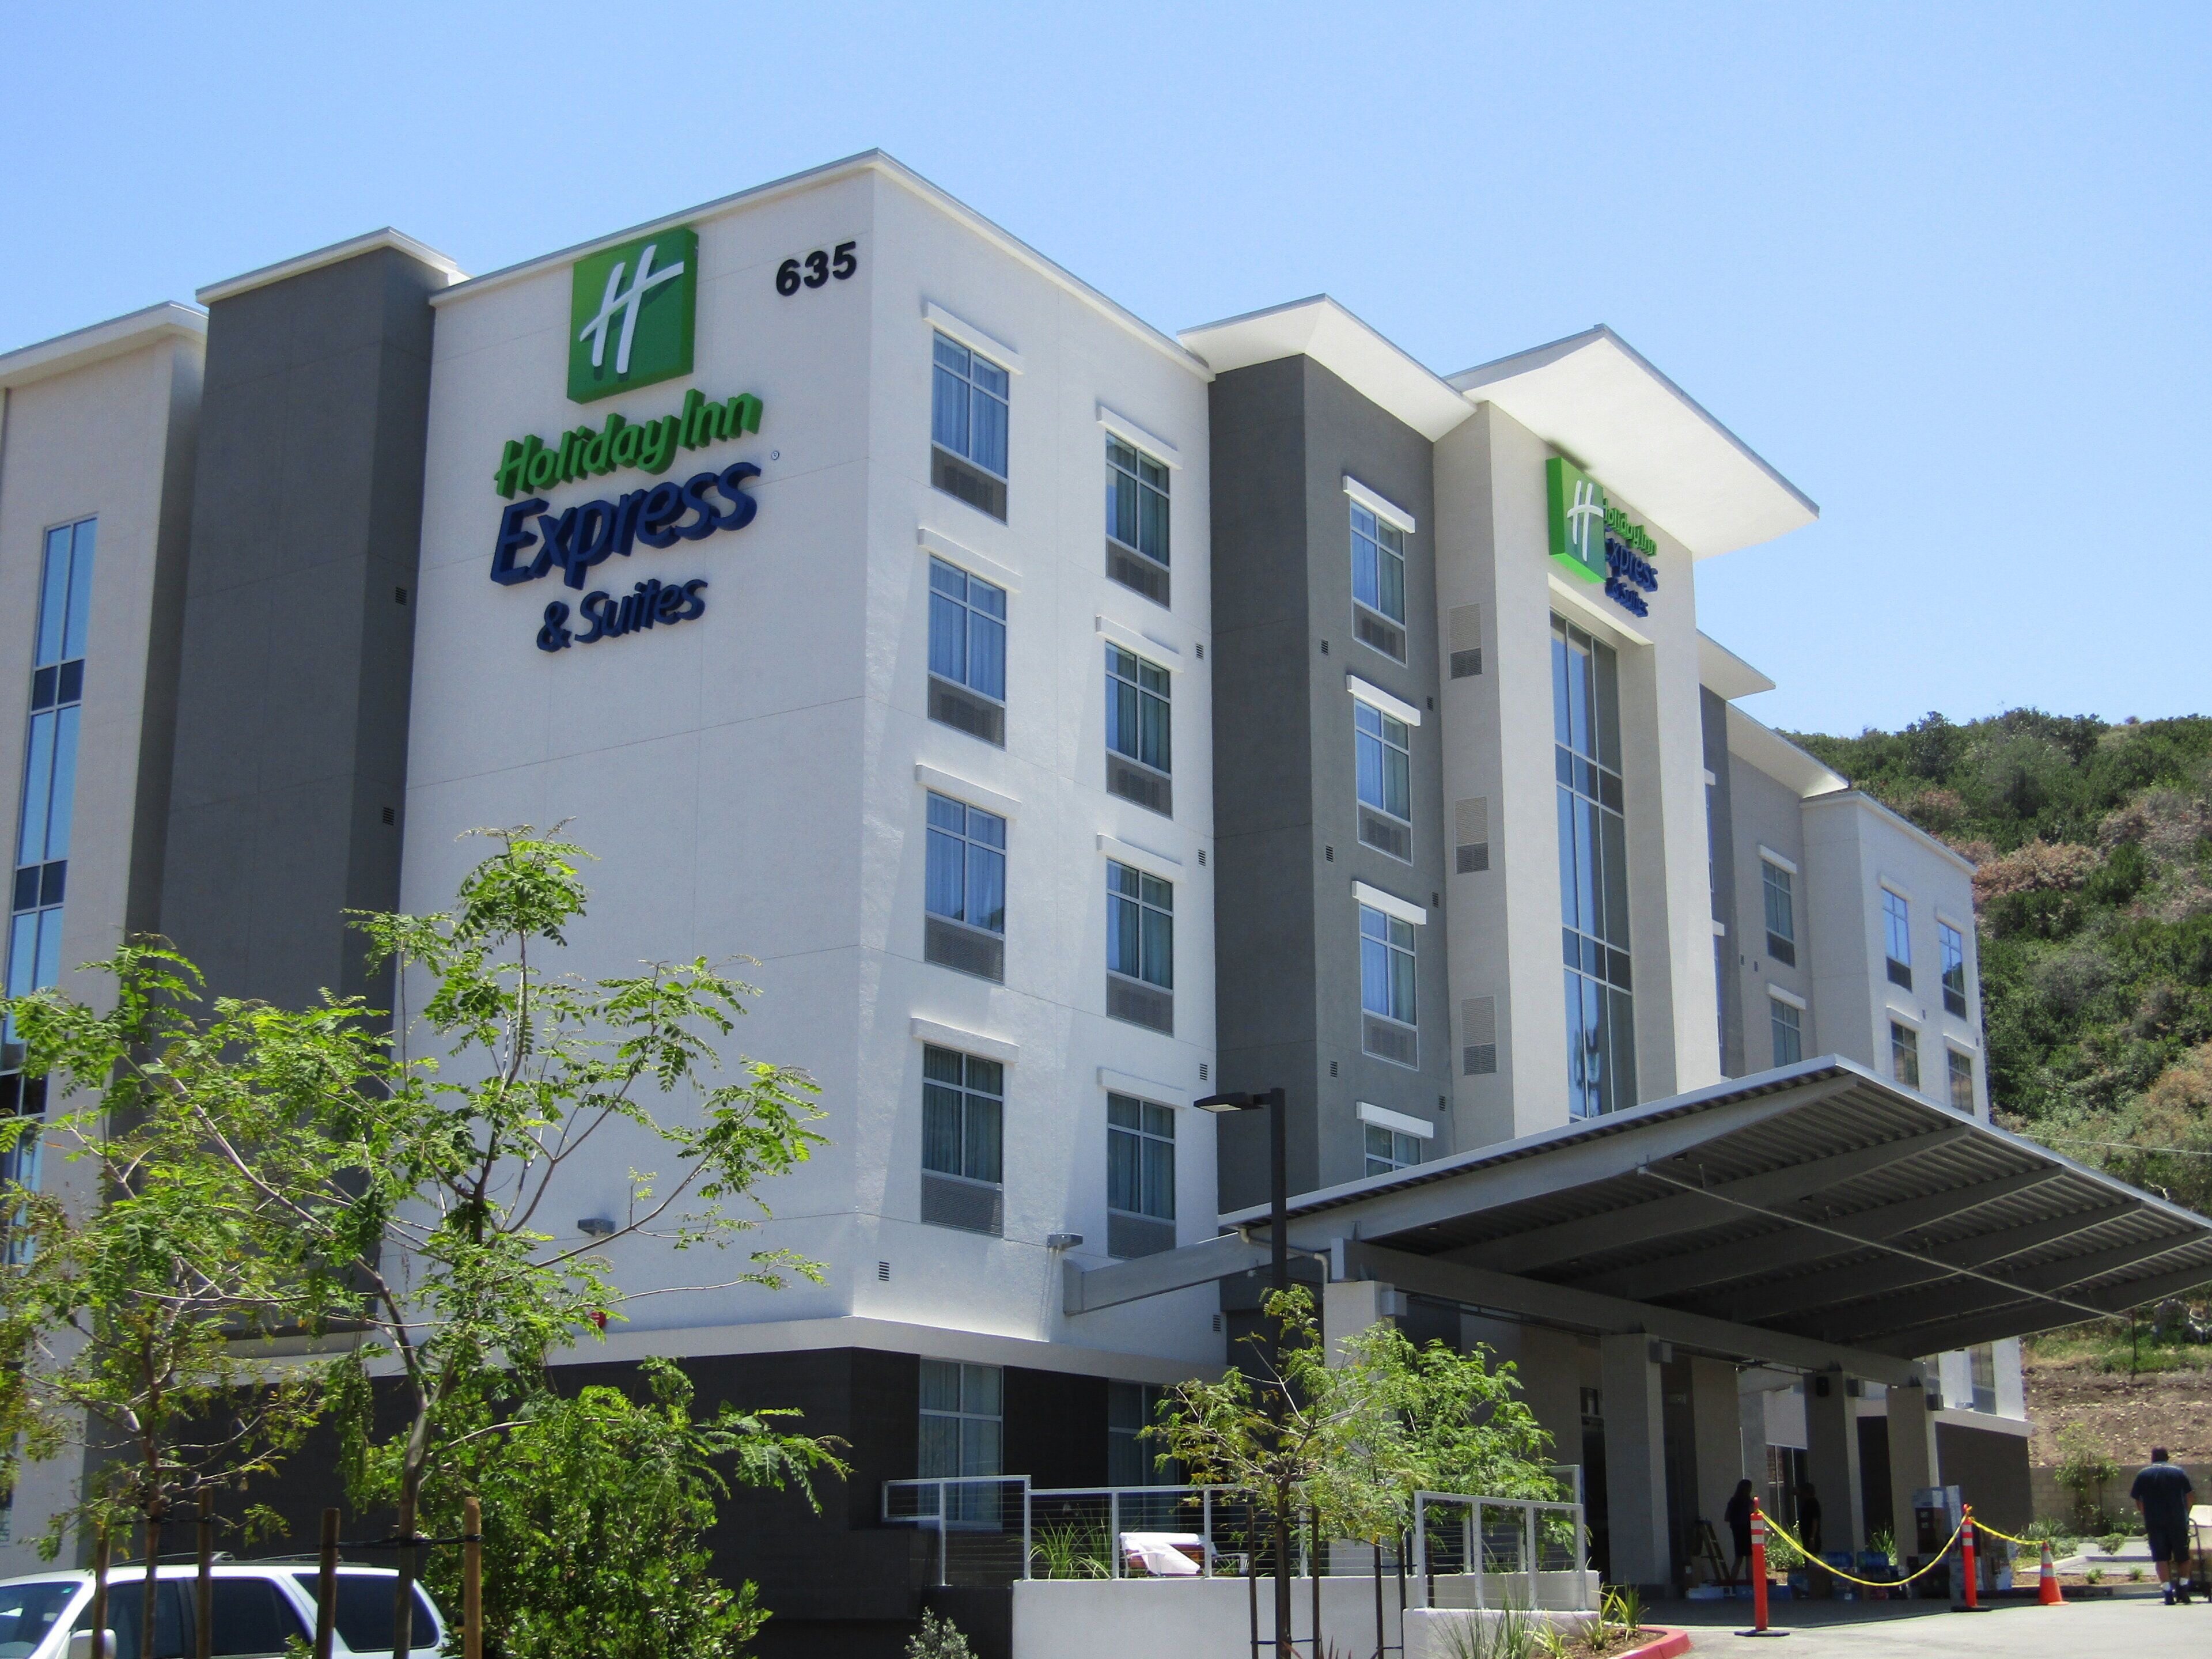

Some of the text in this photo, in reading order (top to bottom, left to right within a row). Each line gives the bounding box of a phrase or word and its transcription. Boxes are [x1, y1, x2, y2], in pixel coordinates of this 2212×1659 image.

[580, 245, 684, 374] H
[776, 241, 857, 297] 635
[495, 389, 763, 500] Holiday Inn
[491, 462, 762, 590] Express
[1567, 480, 1604, 562] H
[537, 578, 708, 653] & Suites
